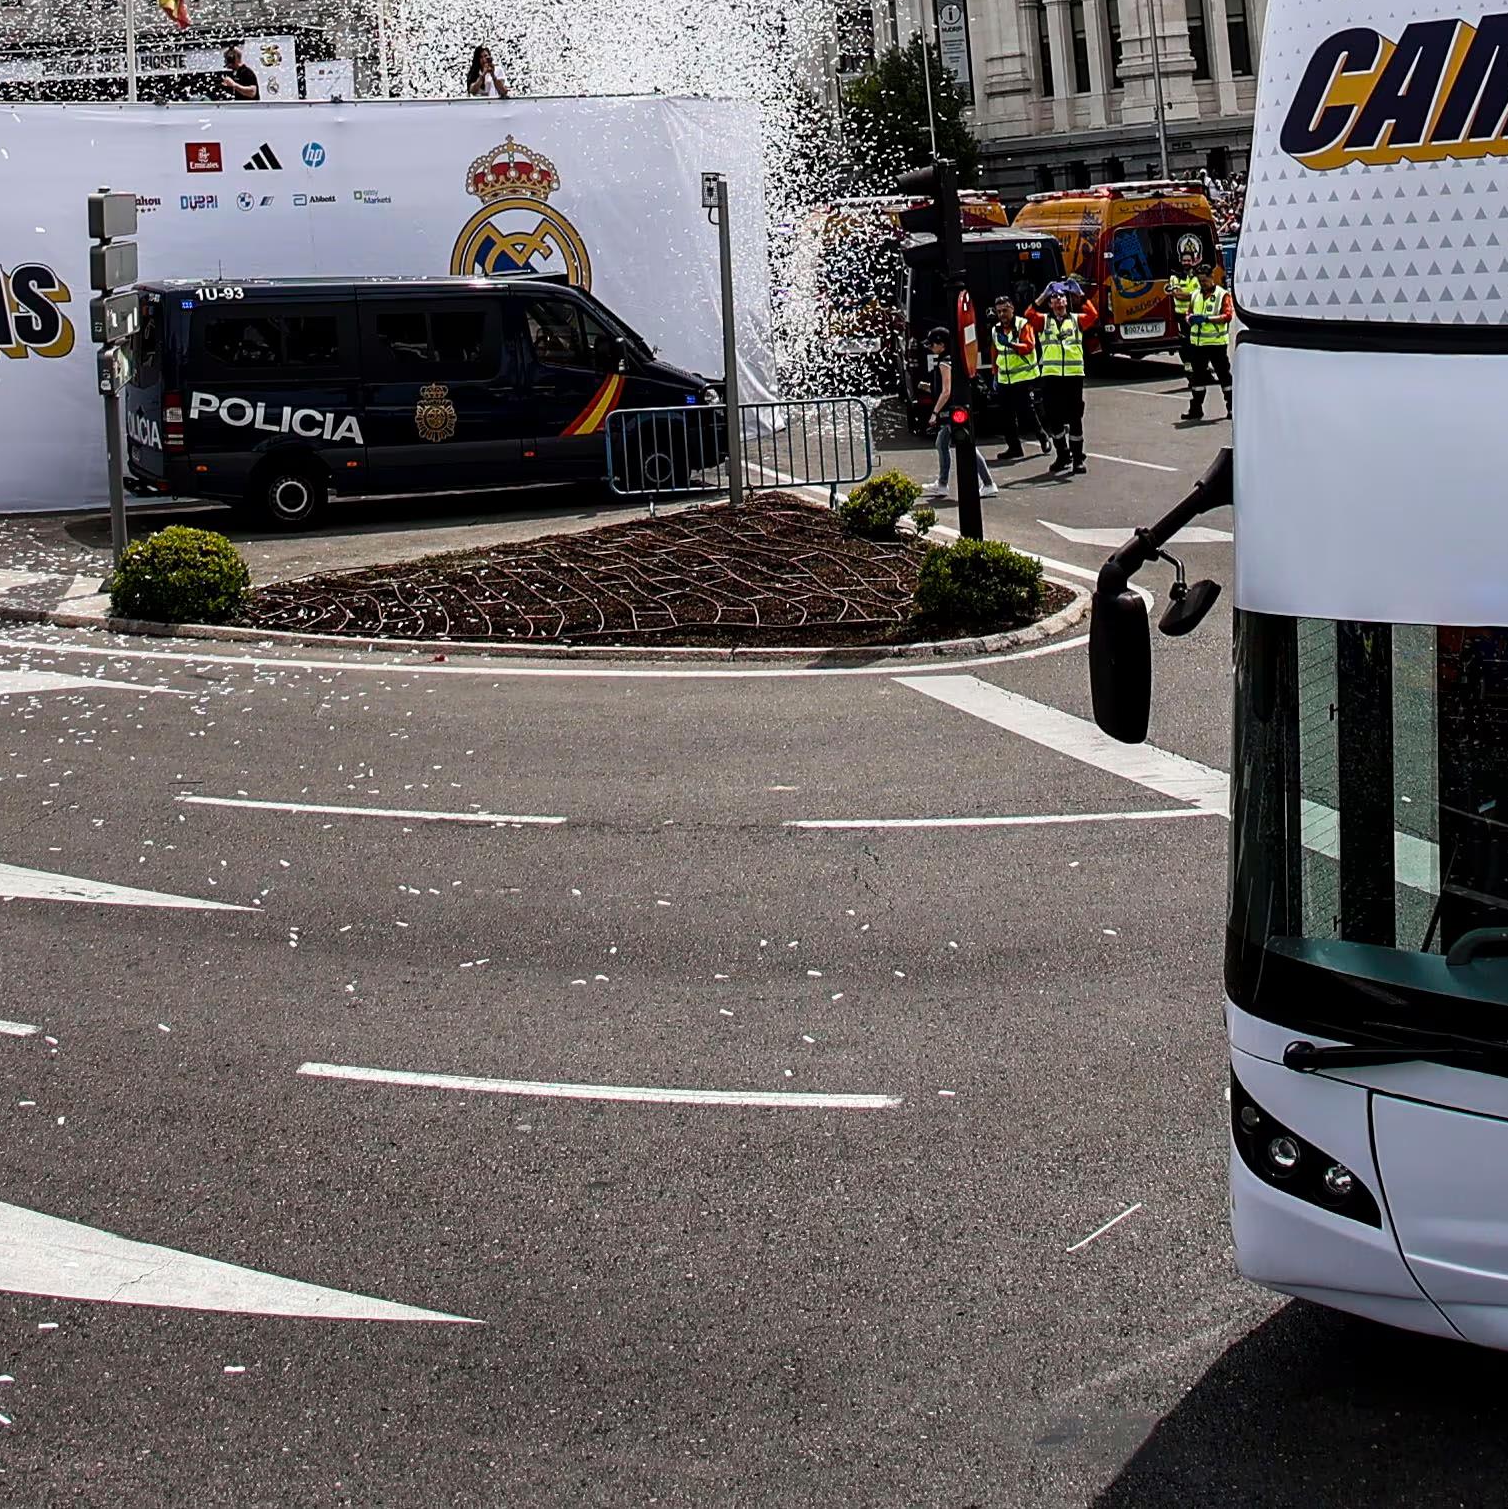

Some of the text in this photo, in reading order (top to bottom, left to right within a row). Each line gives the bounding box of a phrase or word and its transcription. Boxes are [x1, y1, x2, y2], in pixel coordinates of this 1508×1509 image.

[303, 142, 325, 168] hp
[189, 161, 220, 170] Emirates
[136, 196, 161, 206] ahou
[309, 195, 337, 204] Abbott
[1015, 242, 1042, 251] 1U-90
[194, 287, 245, 302] 1U-93
[188, 391, 364, 445] POLICIA
[127, 410, 163, 451] OLICIA
